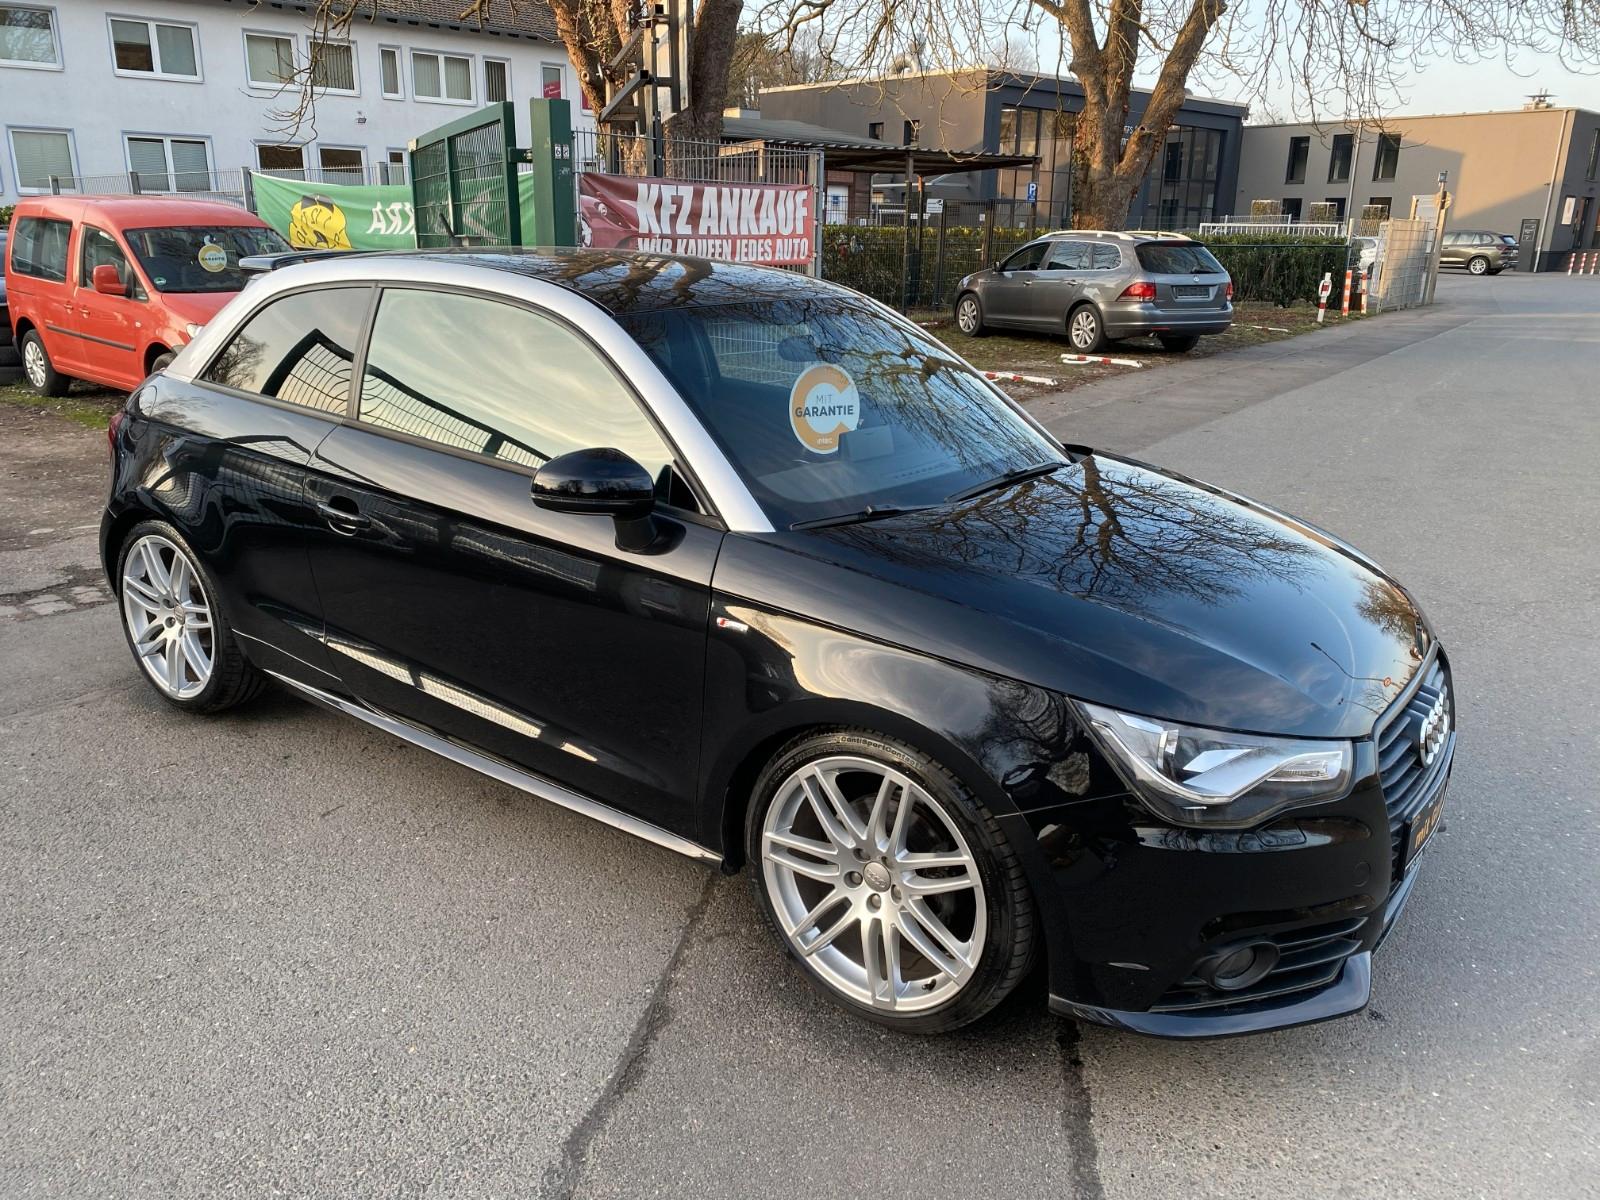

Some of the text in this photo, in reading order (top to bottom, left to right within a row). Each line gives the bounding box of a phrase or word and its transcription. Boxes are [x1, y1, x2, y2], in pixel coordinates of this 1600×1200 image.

[637, 183, 808, 235] KFZ ANKAUF
[637, 237, 808, 261] WIR KAUFEN JEDES AUTO
[816, 395, 832, 405] MIT
[795, 405, 854, 417] GARANTIE
